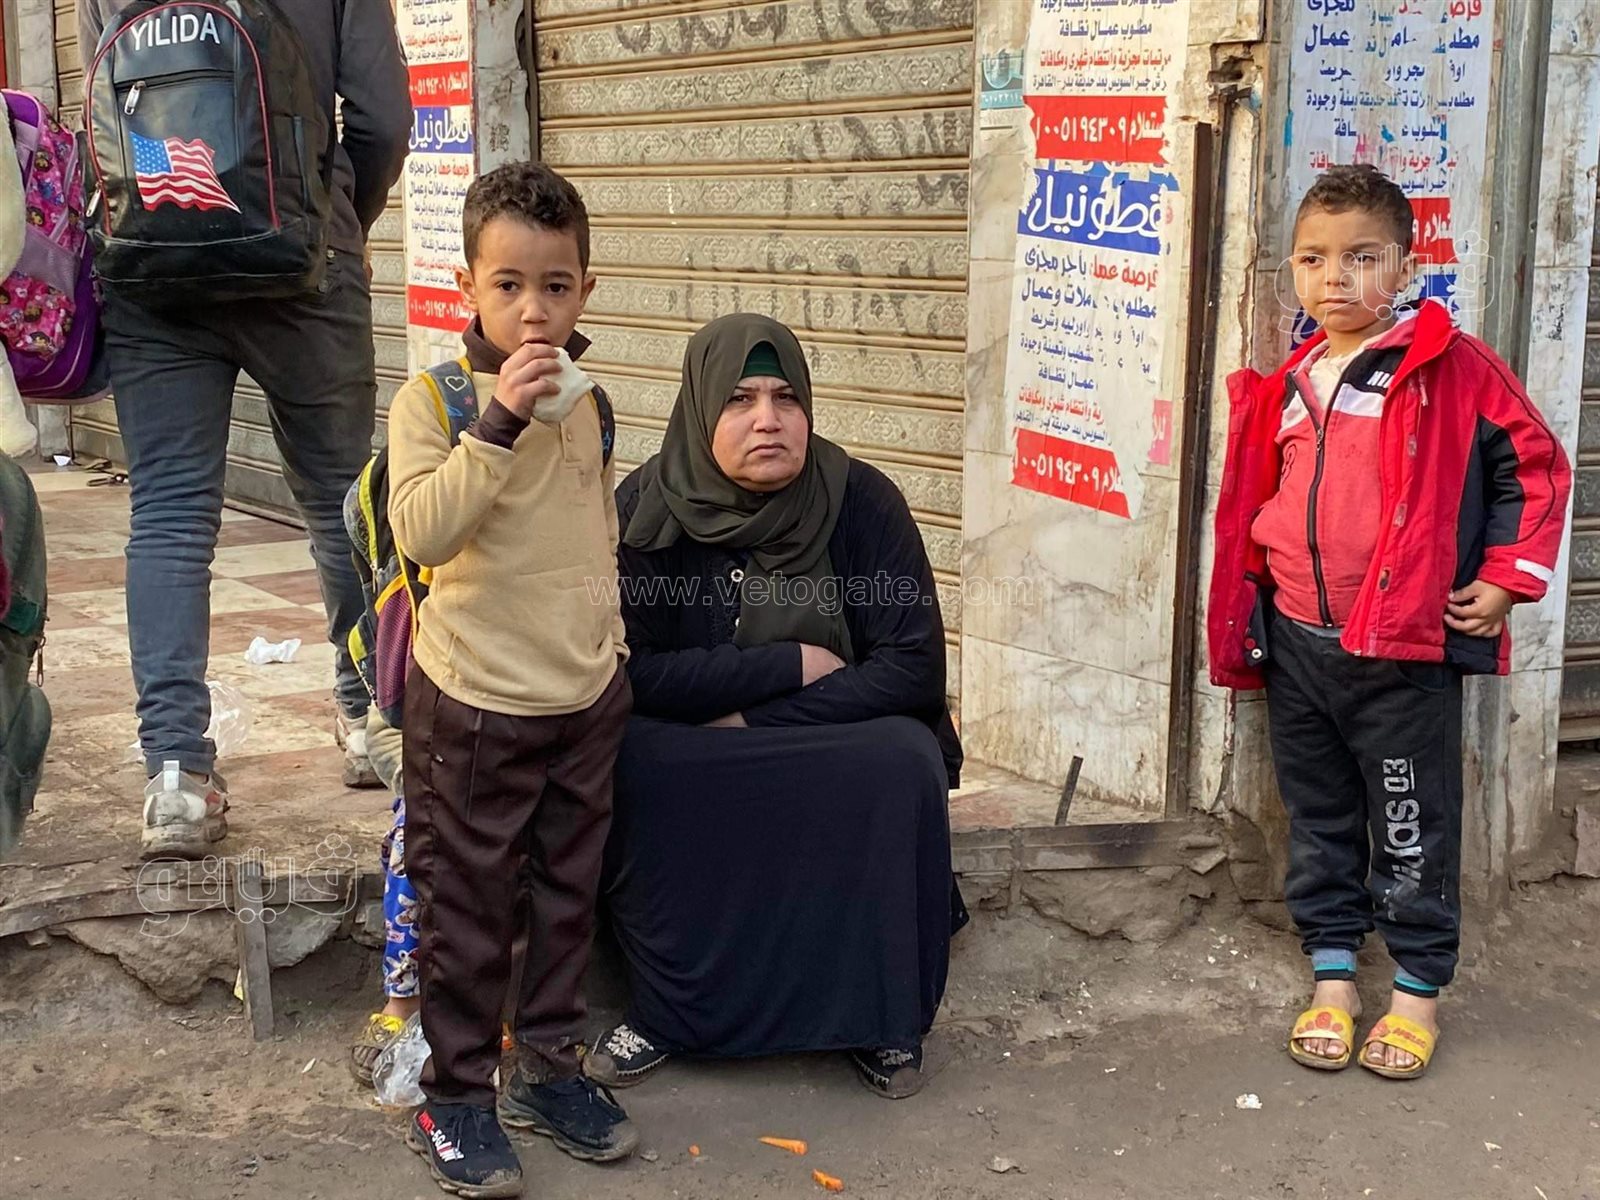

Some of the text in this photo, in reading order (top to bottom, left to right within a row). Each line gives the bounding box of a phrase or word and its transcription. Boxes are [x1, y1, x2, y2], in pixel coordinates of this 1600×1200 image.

[130, 12, 221, 51] YILIDA
[1059, 19, 1089, 37] نظافة
[1090, 19, 1119, 41] عمال
[1074, 73, 1095, 92] حديقة
[1025, 245, 1059, 273] مجزى
[1021, 277, 1062, 307] وعمال
[1038, 361, 1095, 390] عمال نظافة
[1383, 758, 1410, 793] 03
